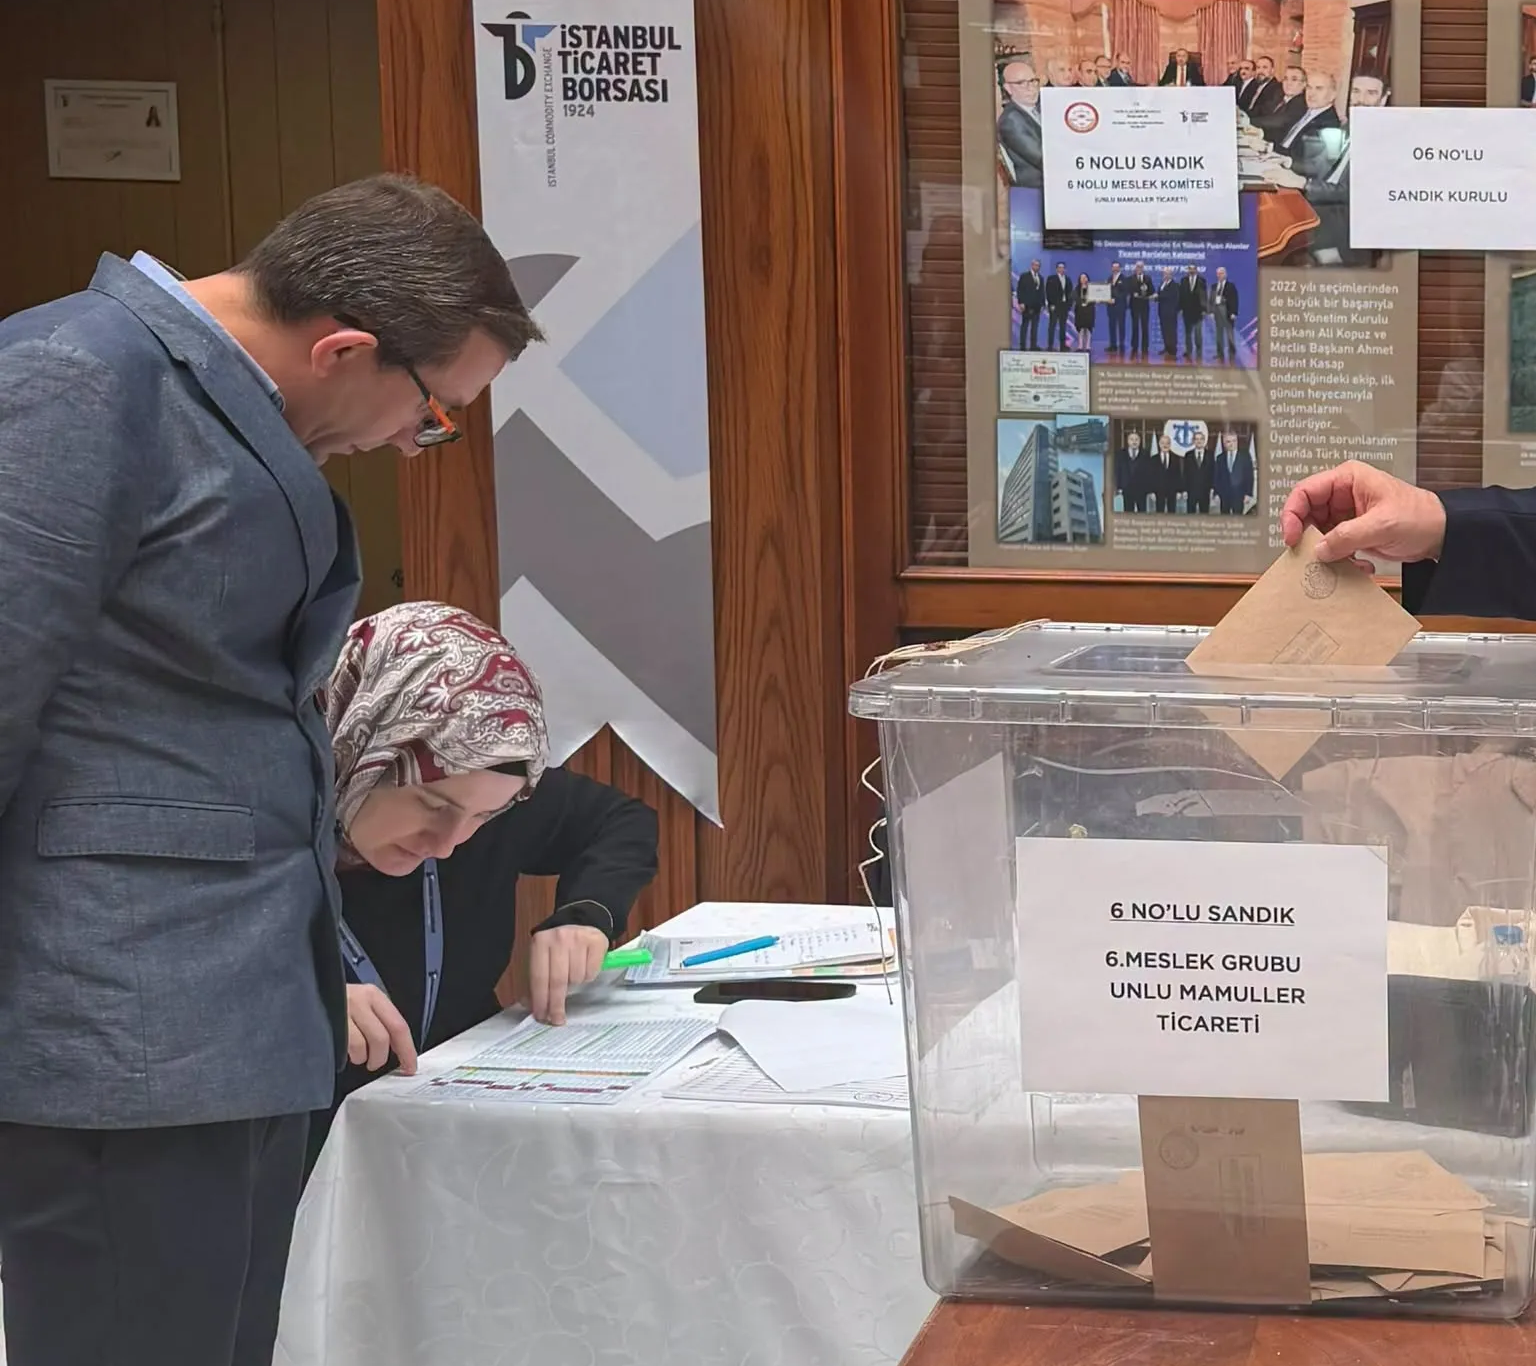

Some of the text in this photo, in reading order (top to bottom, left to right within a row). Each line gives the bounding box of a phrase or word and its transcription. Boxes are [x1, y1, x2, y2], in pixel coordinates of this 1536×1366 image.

[562, 77, 669, 103] BORSASI
[563, 104, 595, 117] 1924
[1412, 147, 1484, 161] 06 NO'LU
[1075, 156, 1205, 170] 6 NOLU SANDIK
[1067, 179, 1074, 189] 6
[1077, 179, 1108, 189] NOLU
[1111, 179, 1158, 189] MESLEK
[1388, 190, 1508, 202] SANDIK KURULU
[1270, 280, 1297, 292] 2022
[1319, 283, 1399, 295] seçimlerinden
[1270, 297, 1394, 311] de büyük bir başarıyla
[1270, 312, 1389, 325] çıkan Yönetim Kurulu
[1270, 327, 1387, 341] Başkanı Ali Kopuz ve
[1270, 342, 1306, 353] Meclis
[1356, 344, 1394, 355] Ahmet
[1270, 357, 1344, 370] Bülent Kasap
[1270, 372, 1350, 386] önderliğindeki
[1270, 388, 1305, 401] günün
[1270, 430, 1326, 445] Üyelerinin
[1316, 448, 1341, 460] Türk
[1110, 902, 1296, 924] 6 NO'LU SANDIK
[1105, 950, 1302, 973] 6.MESLEK GRUBU
[1110, 982, 1307, 1005] UNLU MAMULLER
[1156, 1011, 1260, 1034] TİCARETİ
